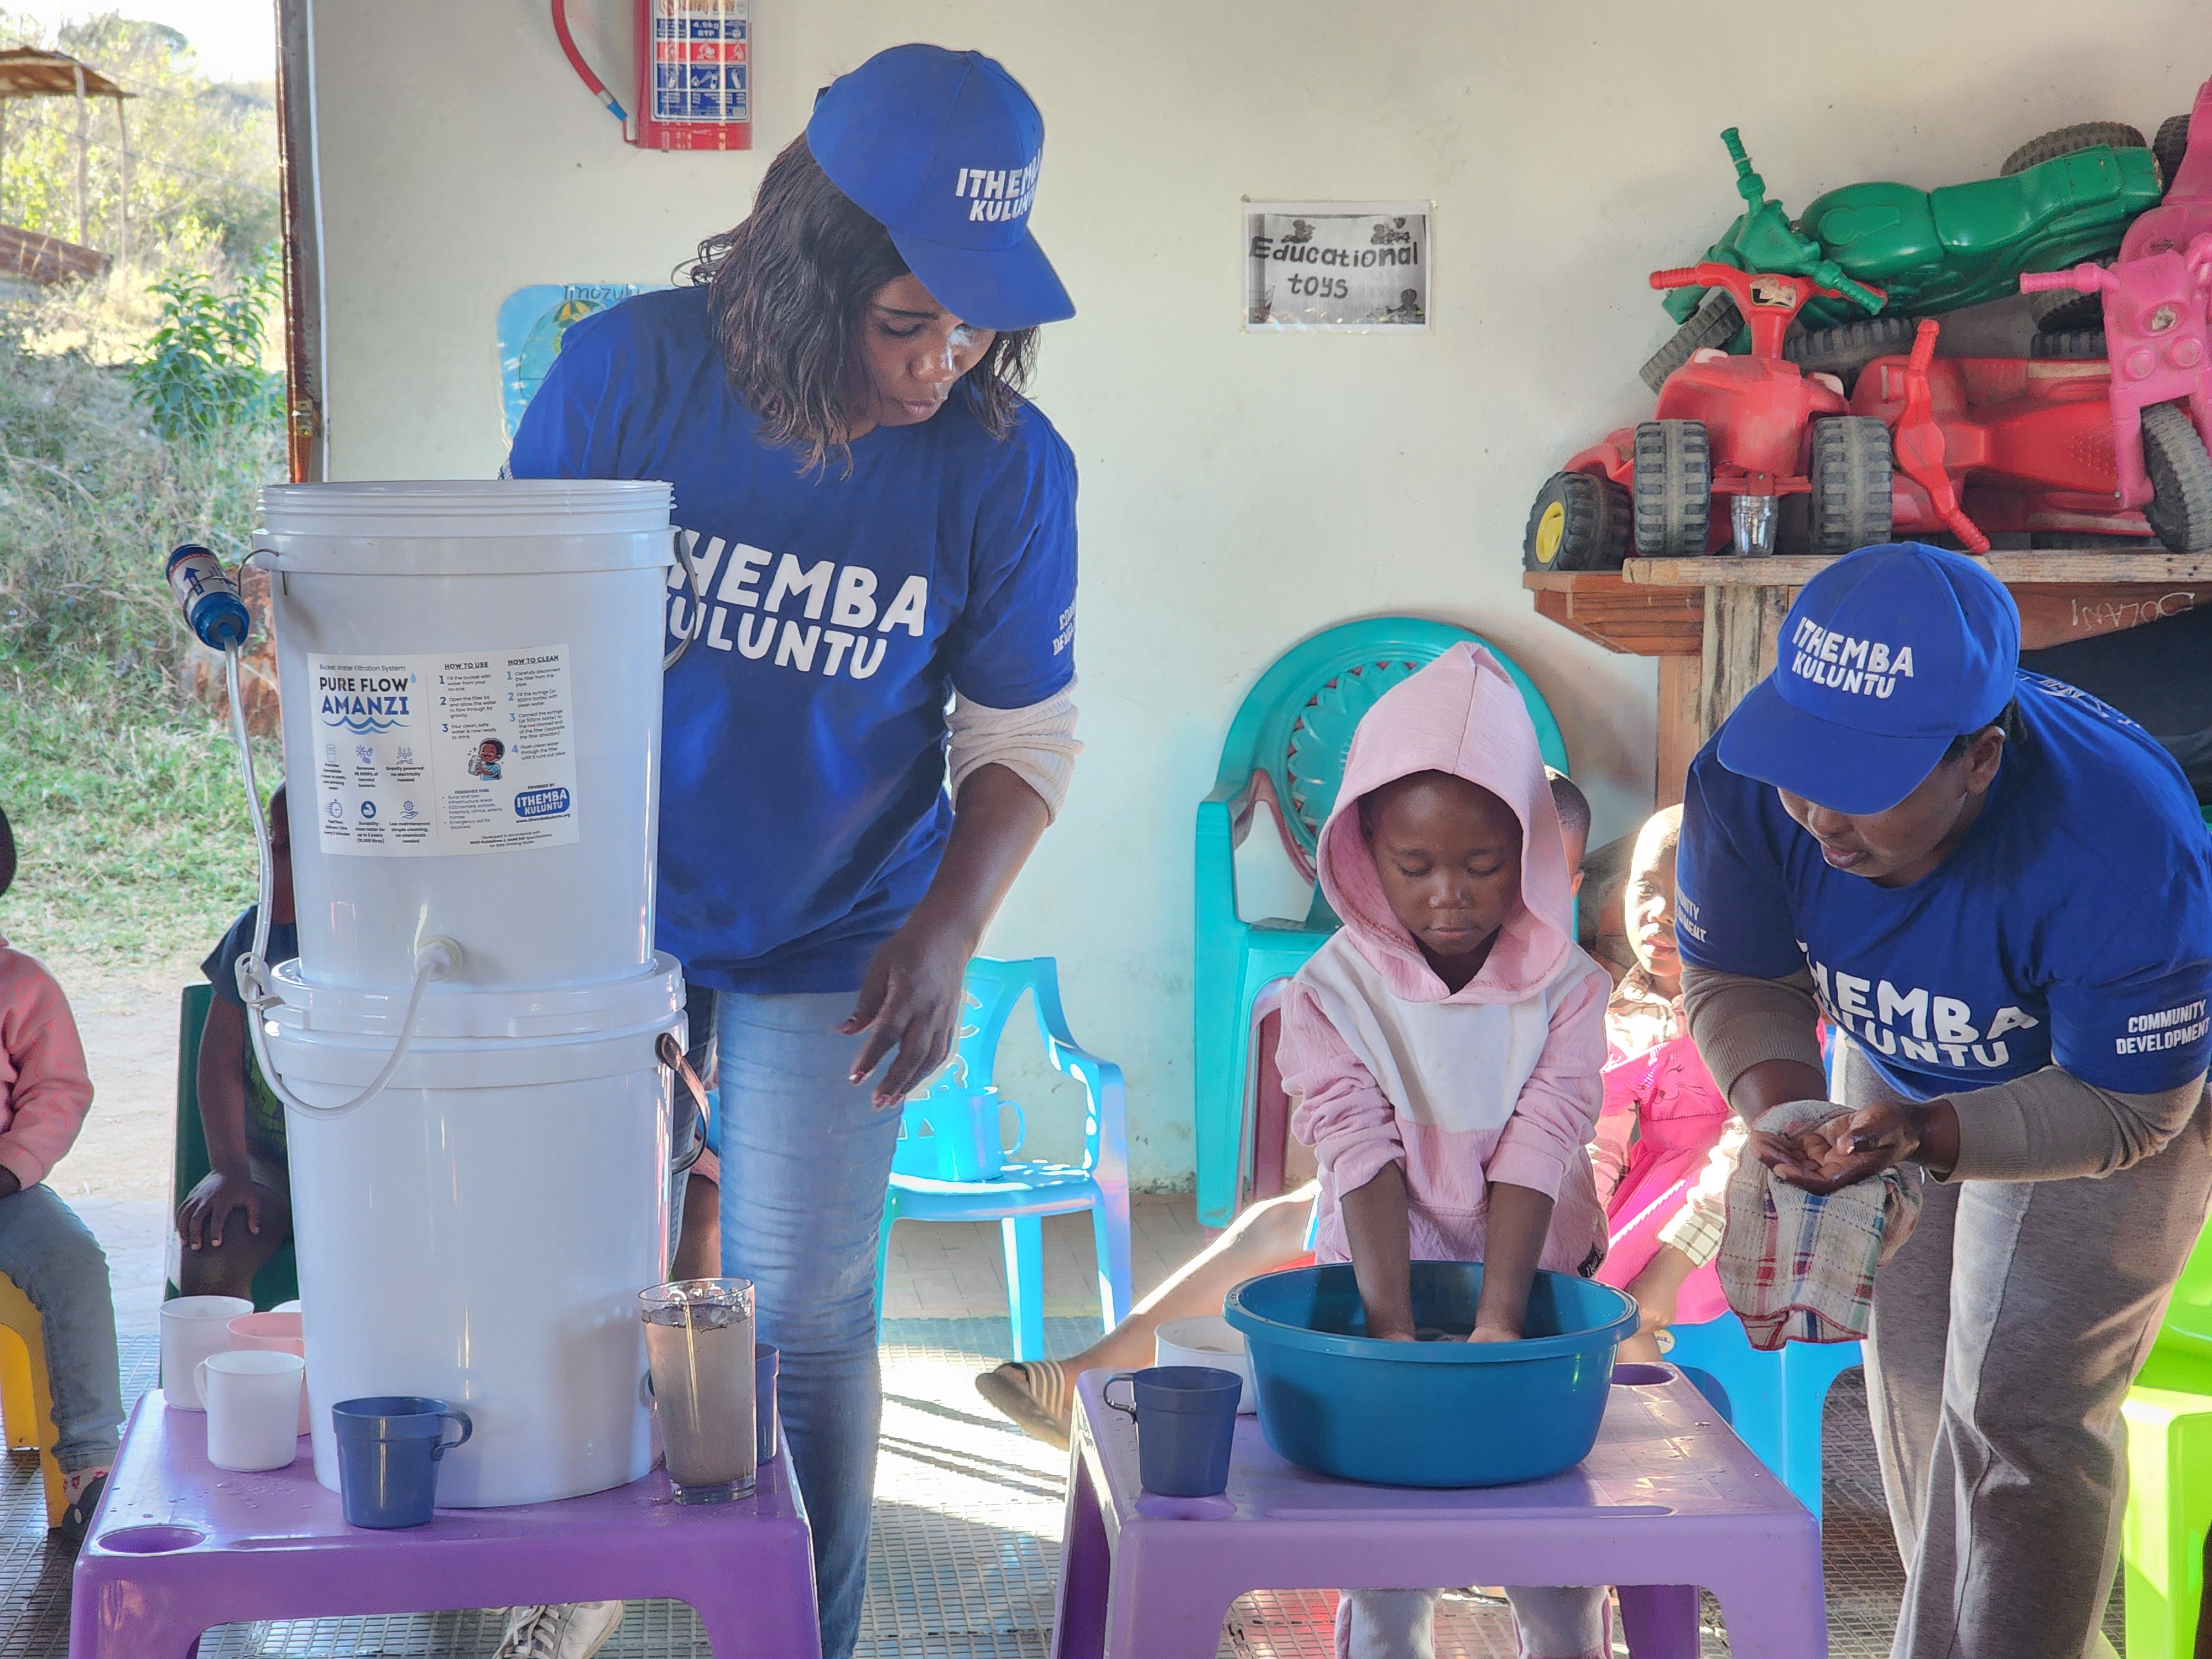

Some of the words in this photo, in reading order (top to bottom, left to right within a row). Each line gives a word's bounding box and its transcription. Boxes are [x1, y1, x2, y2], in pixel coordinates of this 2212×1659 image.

[1250, 236, 1418, 267] Educational
[1287, 273, 1348, 299] toys
[666, 528, 928, 637] HEMBA
[666, 593, 888, 680] ULUNTU
[1792, 617, 1914, 678] ITHEMBA
[439, 675, 445, 684] 1
[507, 671, 512, 680] 1
[1792, 650, 1896, 699] KULUNTU
[320, 677, 356, 692] PURE
[361, 678, 408, 692] FLOW
[322, 695, 409, 715] AMANZI
[440, 696, 446, 705] 2
[508, 692, 514, 701] 2
[509, 713, 515, 722] 3
[442, 723, 448, 732] 3
[512, 744, 518, 753] 4
[517, 789, 567, 808] ITHEMBA
[524, 801, 563, 815] KULUNTU
[2128, 999, 2206, 1033] COMMUNITY
[2116, 1016, 2211, 1055] DEVELOPMENT
